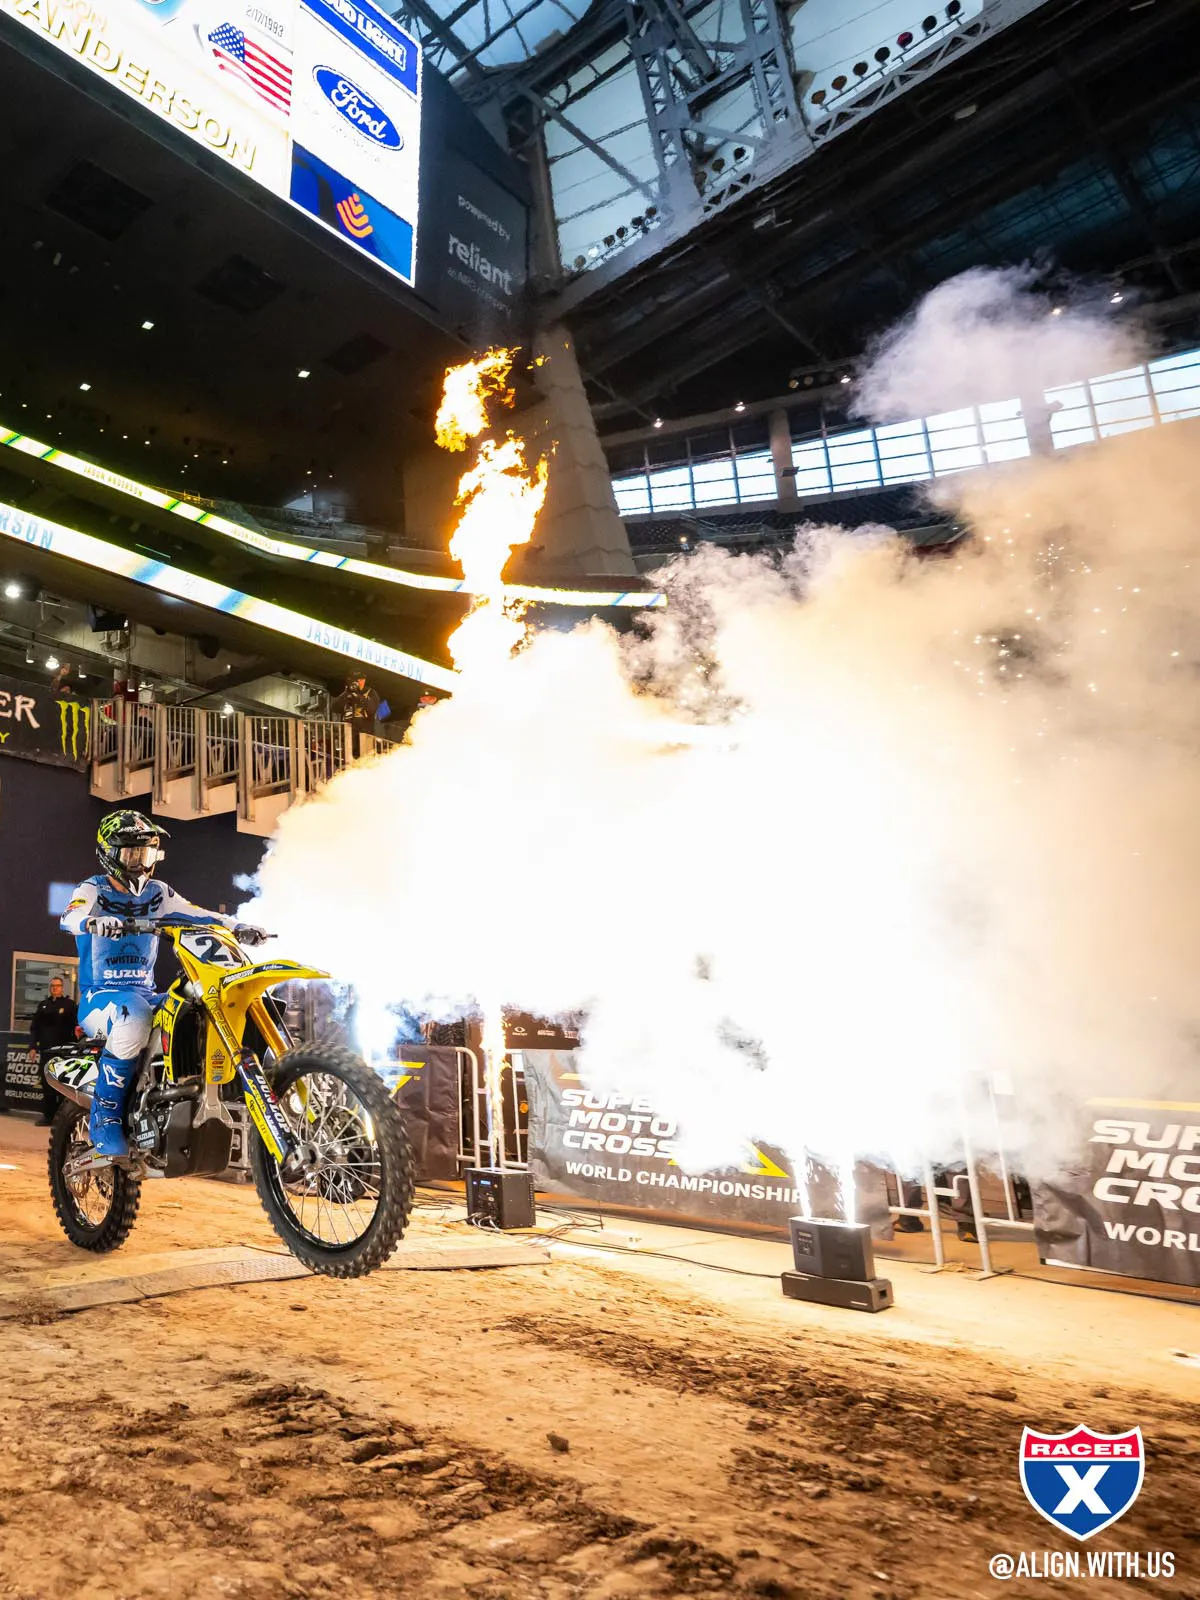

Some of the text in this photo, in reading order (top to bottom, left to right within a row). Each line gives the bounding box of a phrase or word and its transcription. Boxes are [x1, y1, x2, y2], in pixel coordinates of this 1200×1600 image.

[246, 3, 285, 38] 2/17/1993
[357, 13, 404, 66] LIGHT
[13, 0, 257, 171] ANDERSON
[330, 80, 387, 138] Ford
[448, 233, 513, 296] reliant
[306, 622, 424, 682] JASON ANDERSON
[6, 1052, 41, 1064] SUPER
[7, 1063, 40, 1074] MOTO
[57, 1058, 92, 1088] 21
[4, 1089, 22, 1099] WORLD
[5, 1073, 40, 1086] CROSS
[560, 1088, 654, 1113] SUPE
[568, 1109, 679, 1138] MOTO
[562, 1130, 680, 1160] CROSS
[565, 1161, 632, 1182] WORLD
